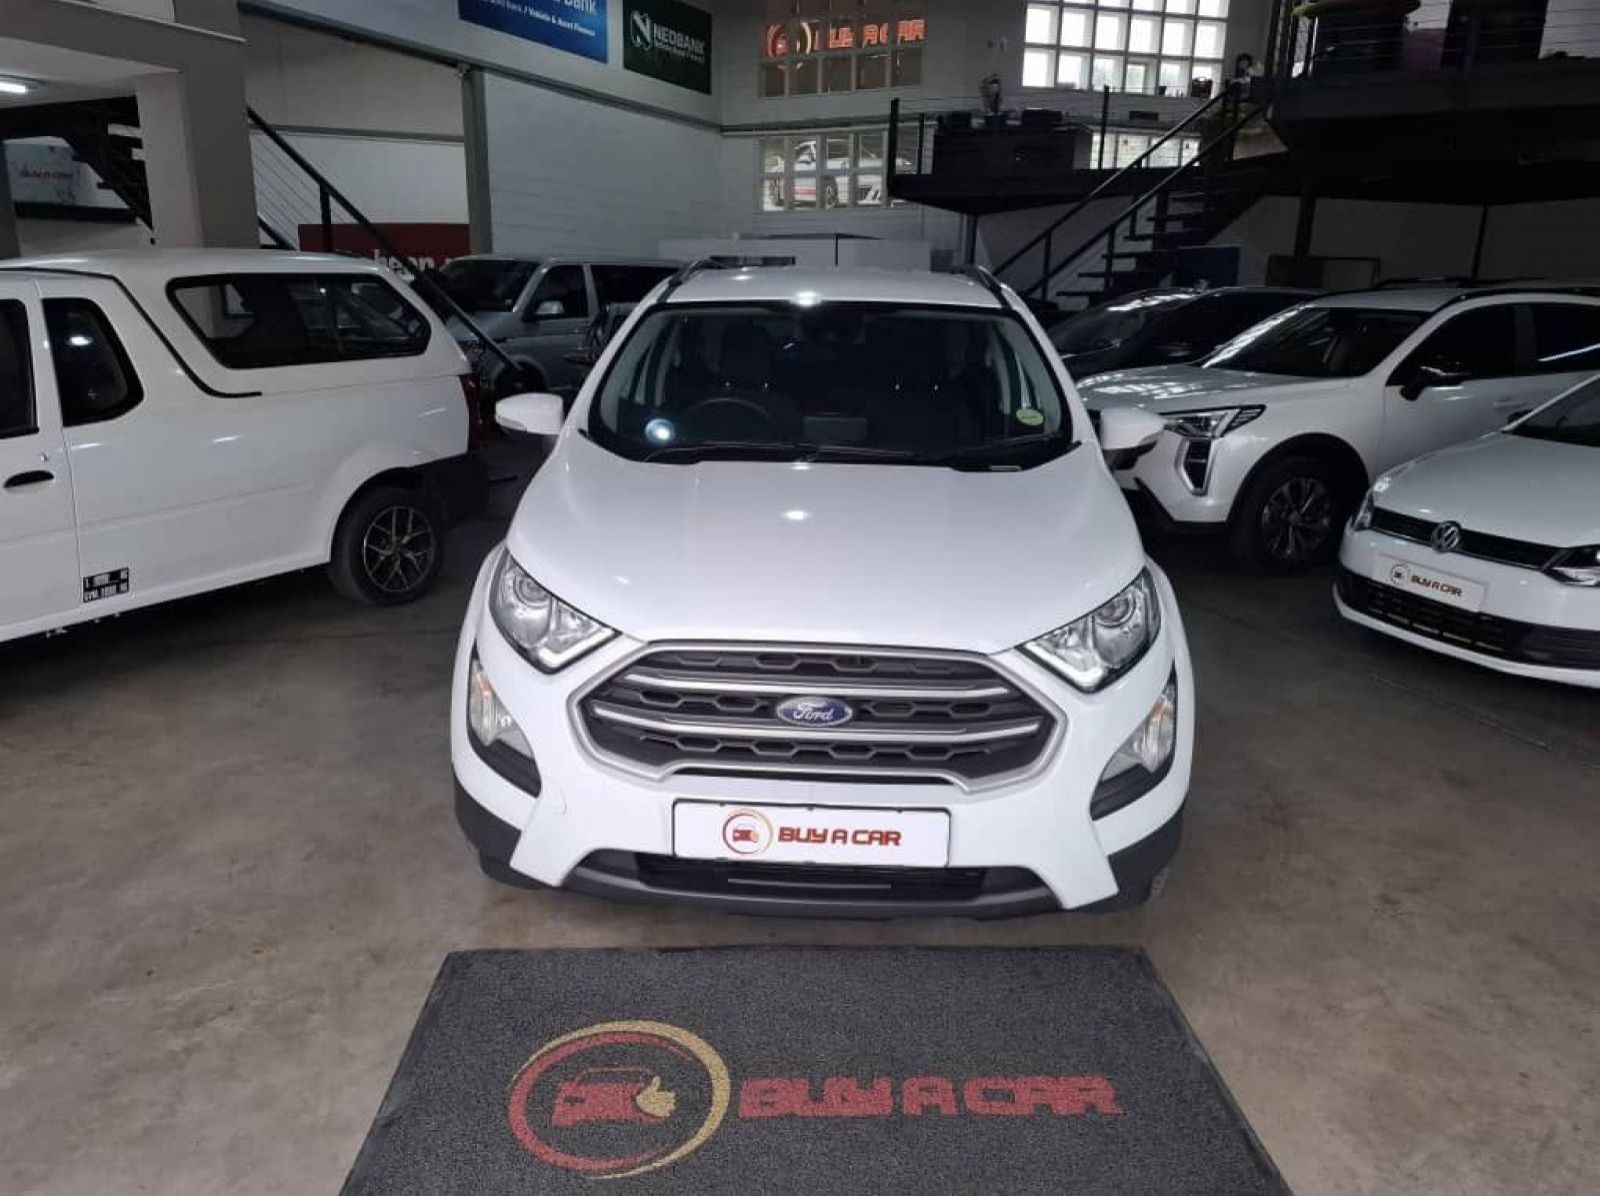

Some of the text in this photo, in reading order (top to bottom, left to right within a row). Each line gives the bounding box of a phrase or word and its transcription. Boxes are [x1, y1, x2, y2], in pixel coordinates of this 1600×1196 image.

[653, 22, 705, 57] NEDBANK
[814, 27, 853, 50] UY
[861, 24, 879, 48] A
[1411, 575, 1462, 596] BUY A CAR
[793, 700, 834, 721] Ford
[778, 826, 902, 846] BUY A CAR
[738, 1076, 1127, 1117] BUY A CAR
